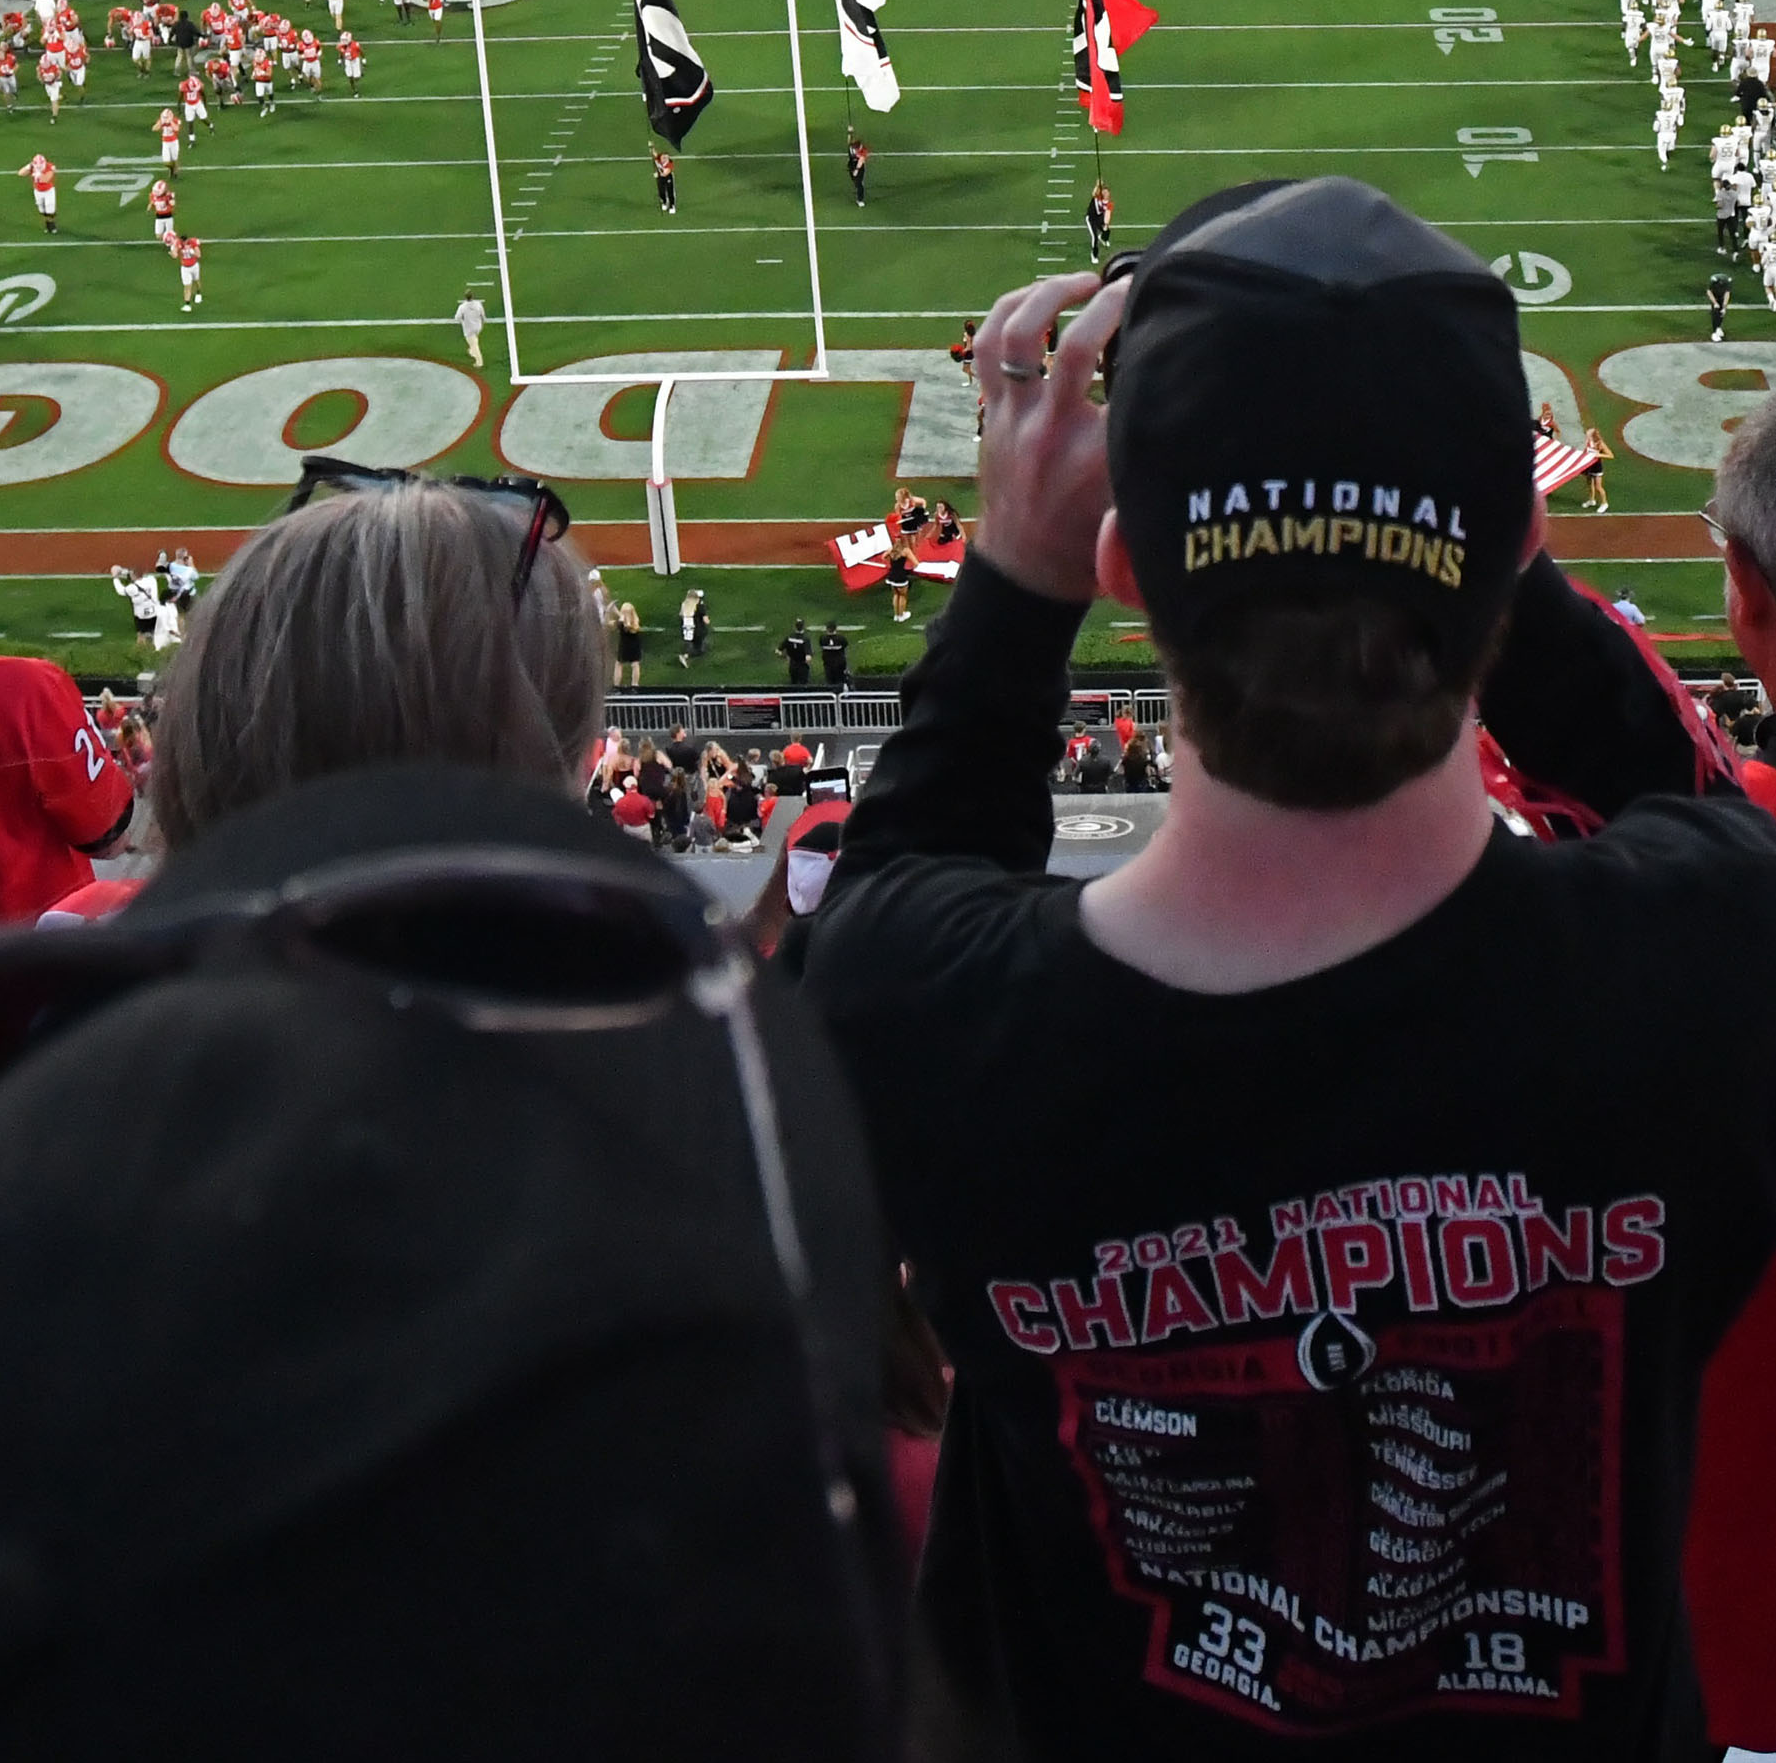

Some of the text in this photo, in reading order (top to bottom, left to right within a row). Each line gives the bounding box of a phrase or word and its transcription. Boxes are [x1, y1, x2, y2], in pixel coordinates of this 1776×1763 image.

[1428, 6, 1505, 44] 20
[1455, 126, 1541, 163] 10
[1187, 478, 1467, 541] NATIONAL
[1184, 514, 1466, 589] CHAMPIONS
[1093, 1169, 1546, 1279] 2021 NATIONAL
[986, 1192, 1667, 1356] CHAMPIONS
[1094, 1399, 1198, 1438] CLEMSON
[1367, 1409, 1473, 1451] MISSOURI
[1139, 1560, 1592, 1664] NATIONAL CHAMPIONSHIP
[1198, 1599, 1268, 1677] 33
[1463, 1631, 1526, 1674] 18
